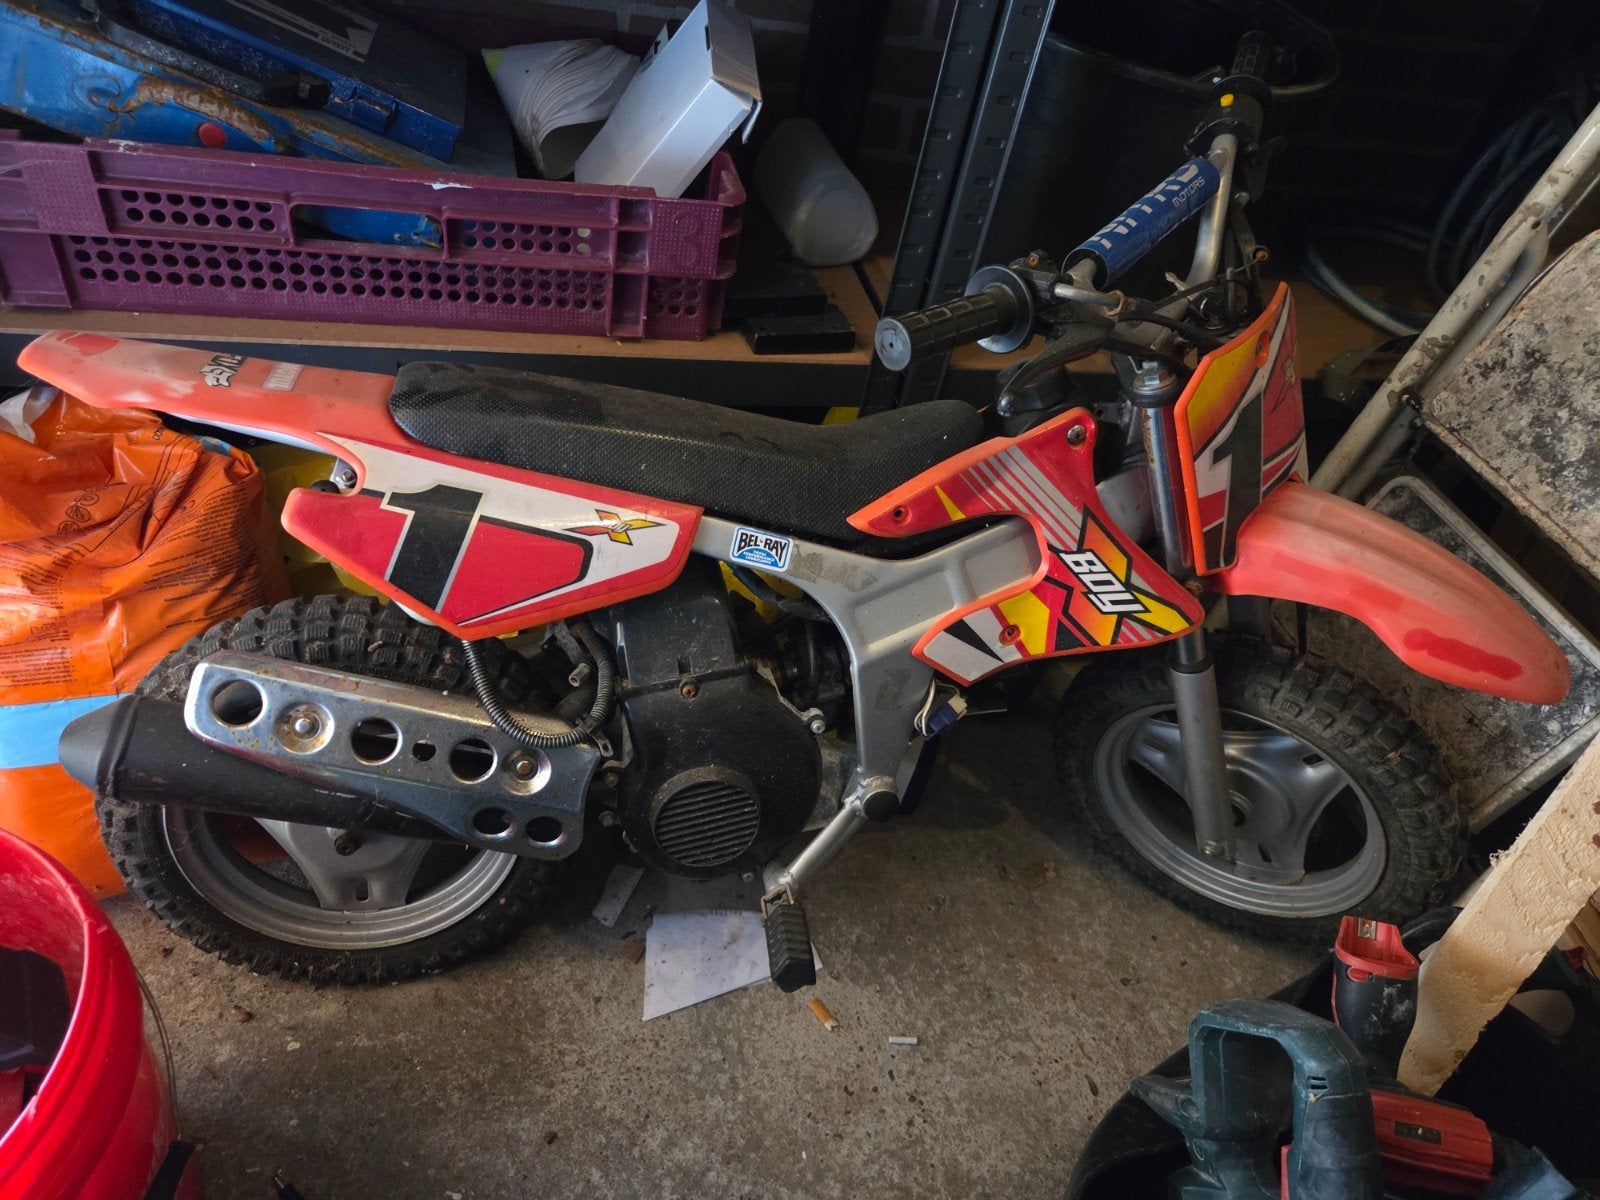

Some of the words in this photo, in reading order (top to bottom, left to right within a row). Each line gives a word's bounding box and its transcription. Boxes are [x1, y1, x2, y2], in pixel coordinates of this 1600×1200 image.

[1171, 176, 1206, 208] MOTORS
[387, 484, 483, 611] 1
[737, 532, 787, 562] BEL-RAY
[1059, 551, 1147, 612] BOY
